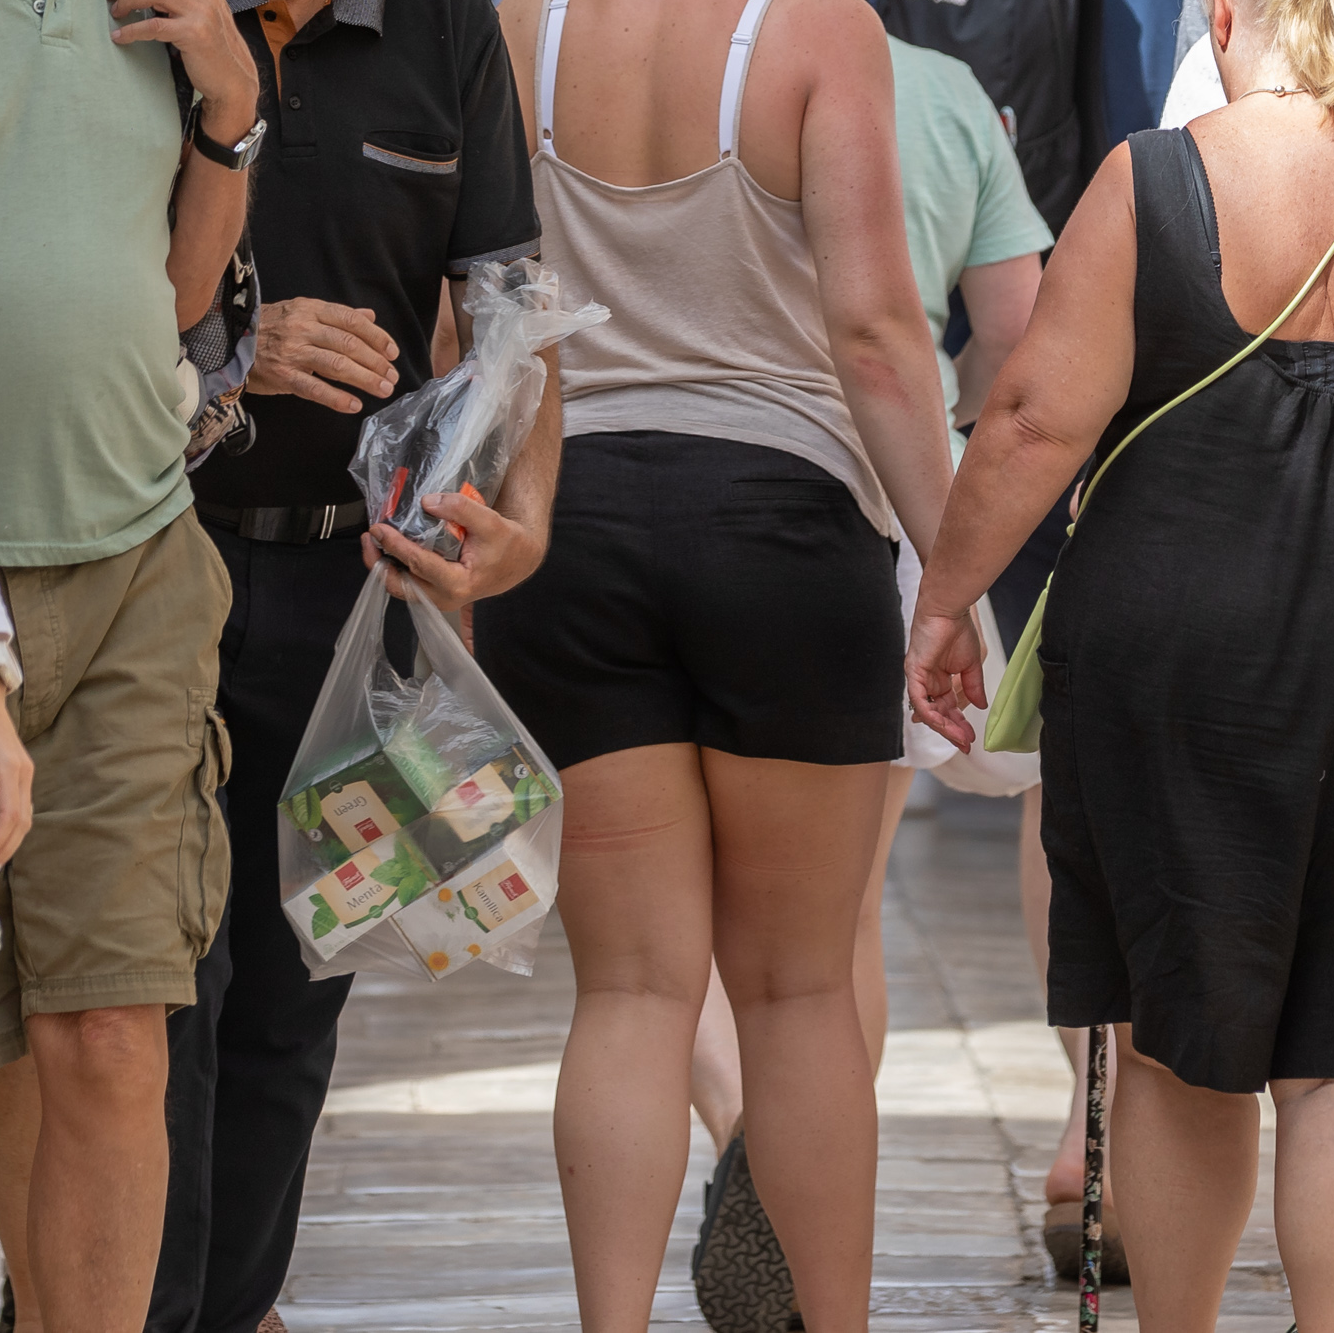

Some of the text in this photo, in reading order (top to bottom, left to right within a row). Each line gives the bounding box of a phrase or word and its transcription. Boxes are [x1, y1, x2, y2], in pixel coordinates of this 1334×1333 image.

[333, 795, 368, 817] Green
[346, 883, 383, 911] Menta
[473, 882, 504, 923] Kamilica
